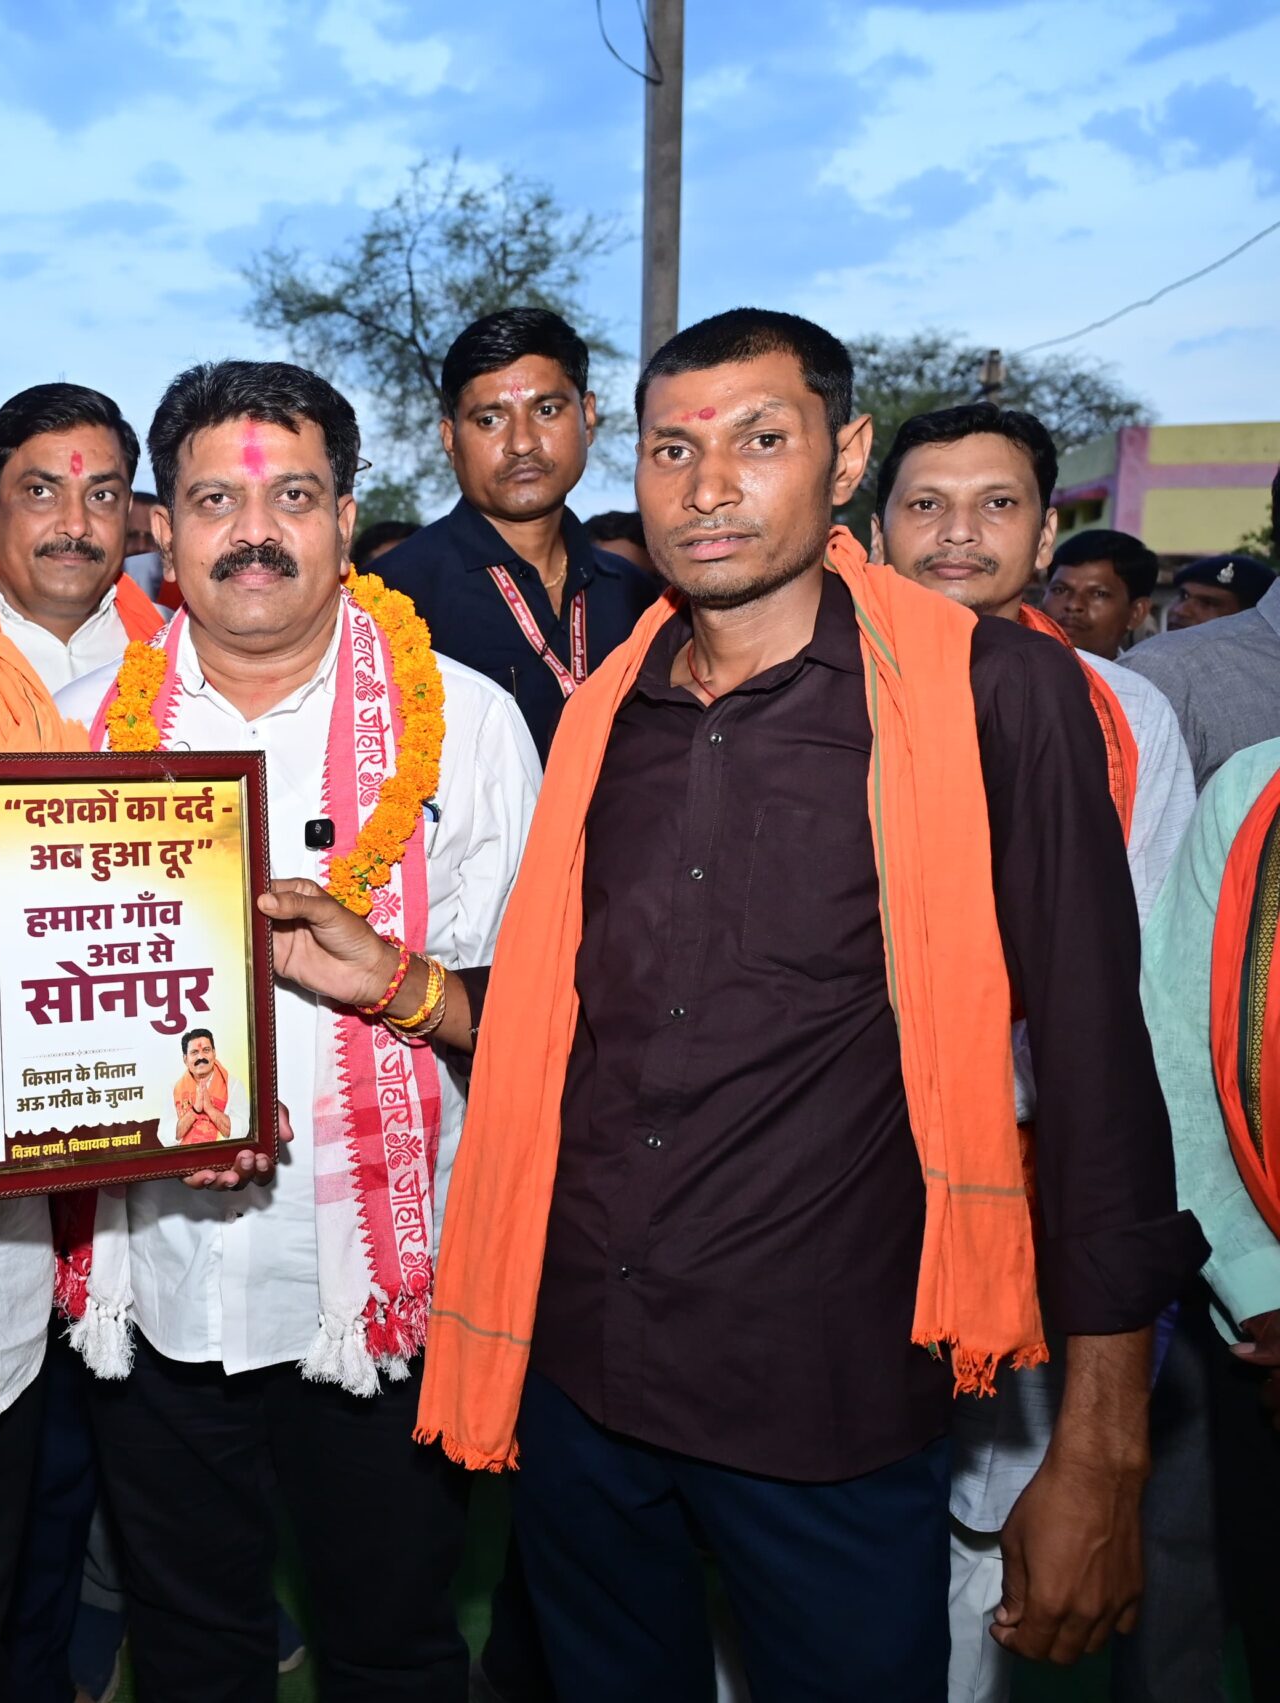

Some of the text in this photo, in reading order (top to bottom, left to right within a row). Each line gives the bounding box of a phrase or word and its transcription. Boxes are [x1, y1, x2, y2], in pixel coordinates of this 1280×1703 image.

[355, 706, 391, 771] जोहार
[4, 789, 119, 827] “दशकों
[125, 797, 167, 821] का
[173, 787, 214, 823] दर्द
[30, 839, 213, 881] अब हुआ दूर”
[24, 891, 183, 937] हमारा गाँव
[87, 933, 175, 967] अब से
[21, 961, 214, 1035] सोनपुर
[22, 1061, 136, 1087] किसान के मितान
[377, 1049, 412, 1134] जोहार
[16, 1086, 144, 1112] अऊ गरीब के जुबान
[12, 1144, 40, 1159] विजय
[42, 1140, 67, 1155] शर्मा,
[68, 1137, 110, 1153] विधायक
[111, 1131, 141, 1147] कवर्धा
[391, 1169, 428, 1259] जोहार
